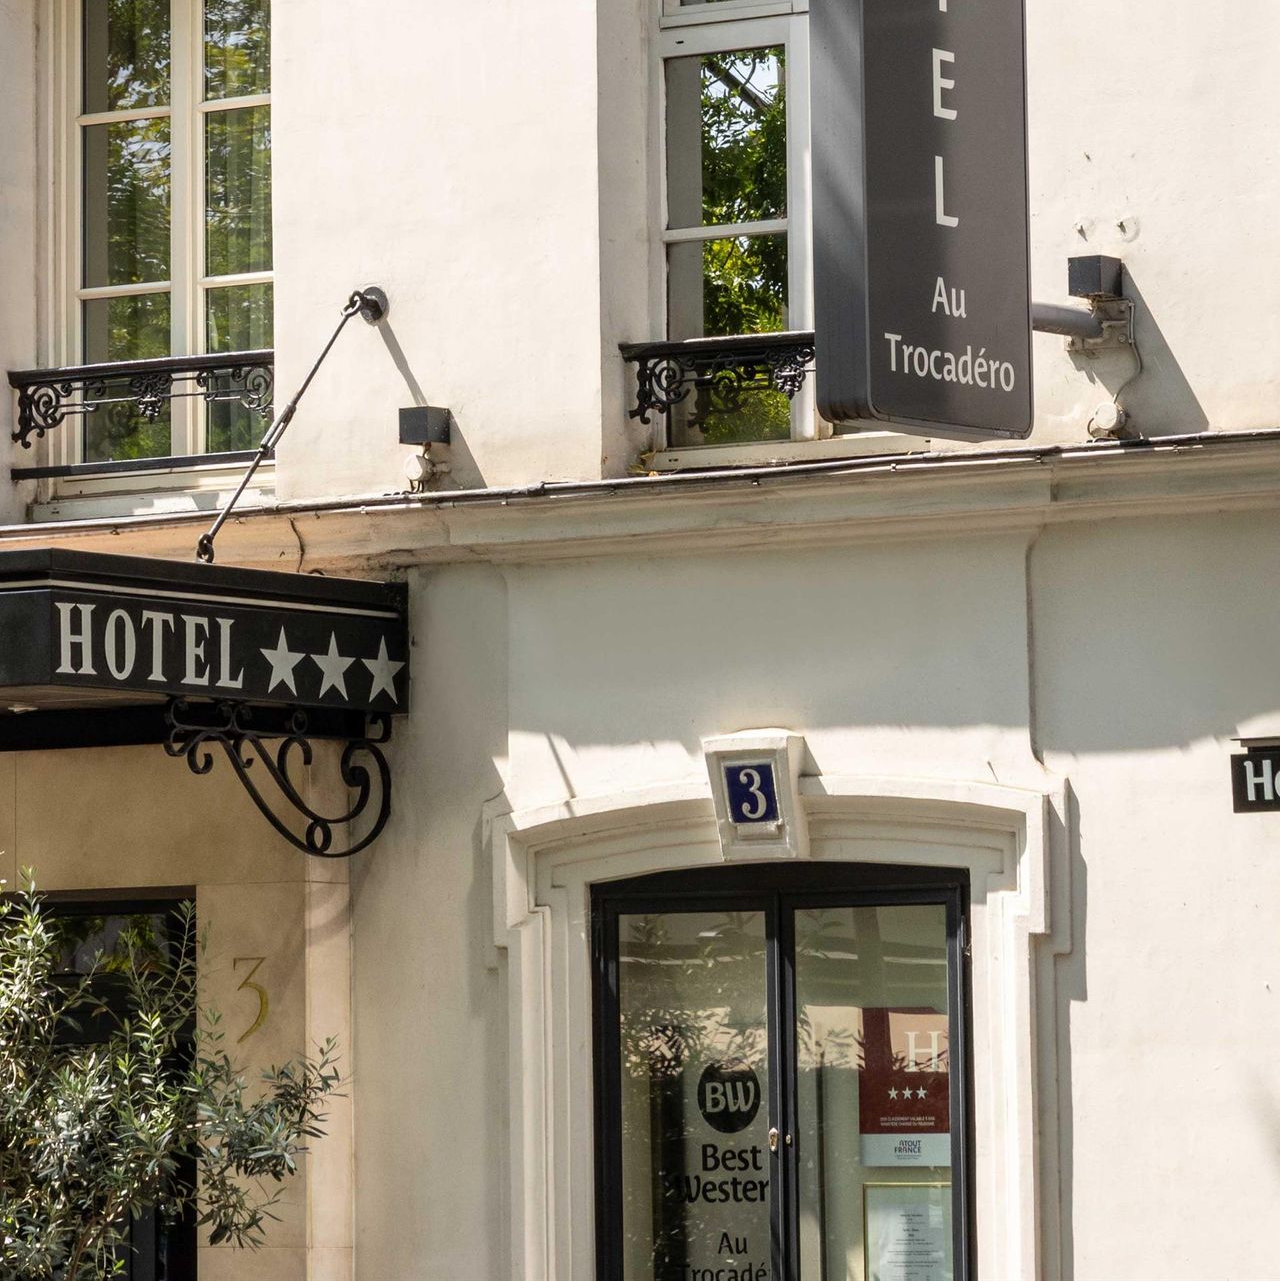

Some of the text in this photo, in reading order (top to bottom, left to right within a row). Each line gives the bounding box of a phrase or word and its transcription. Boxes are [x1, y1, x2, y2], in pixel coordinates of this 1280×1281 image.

[931, 275, 967, 320] Au
[884, 332, 1016, 393] Trocadéro
[54, 601, 245, 690] HOTEL
[739, 768, 767, 819] 3
[233, 956, 269, 1046] 3
[904, 1031, 943, 1072] H
[705, 1080, 755, 1113] BW
[701, 1143, 763, 1171] Best
[678, 1175, 770, 1203] Wester
[718, 1231, 748, 1254] Au
